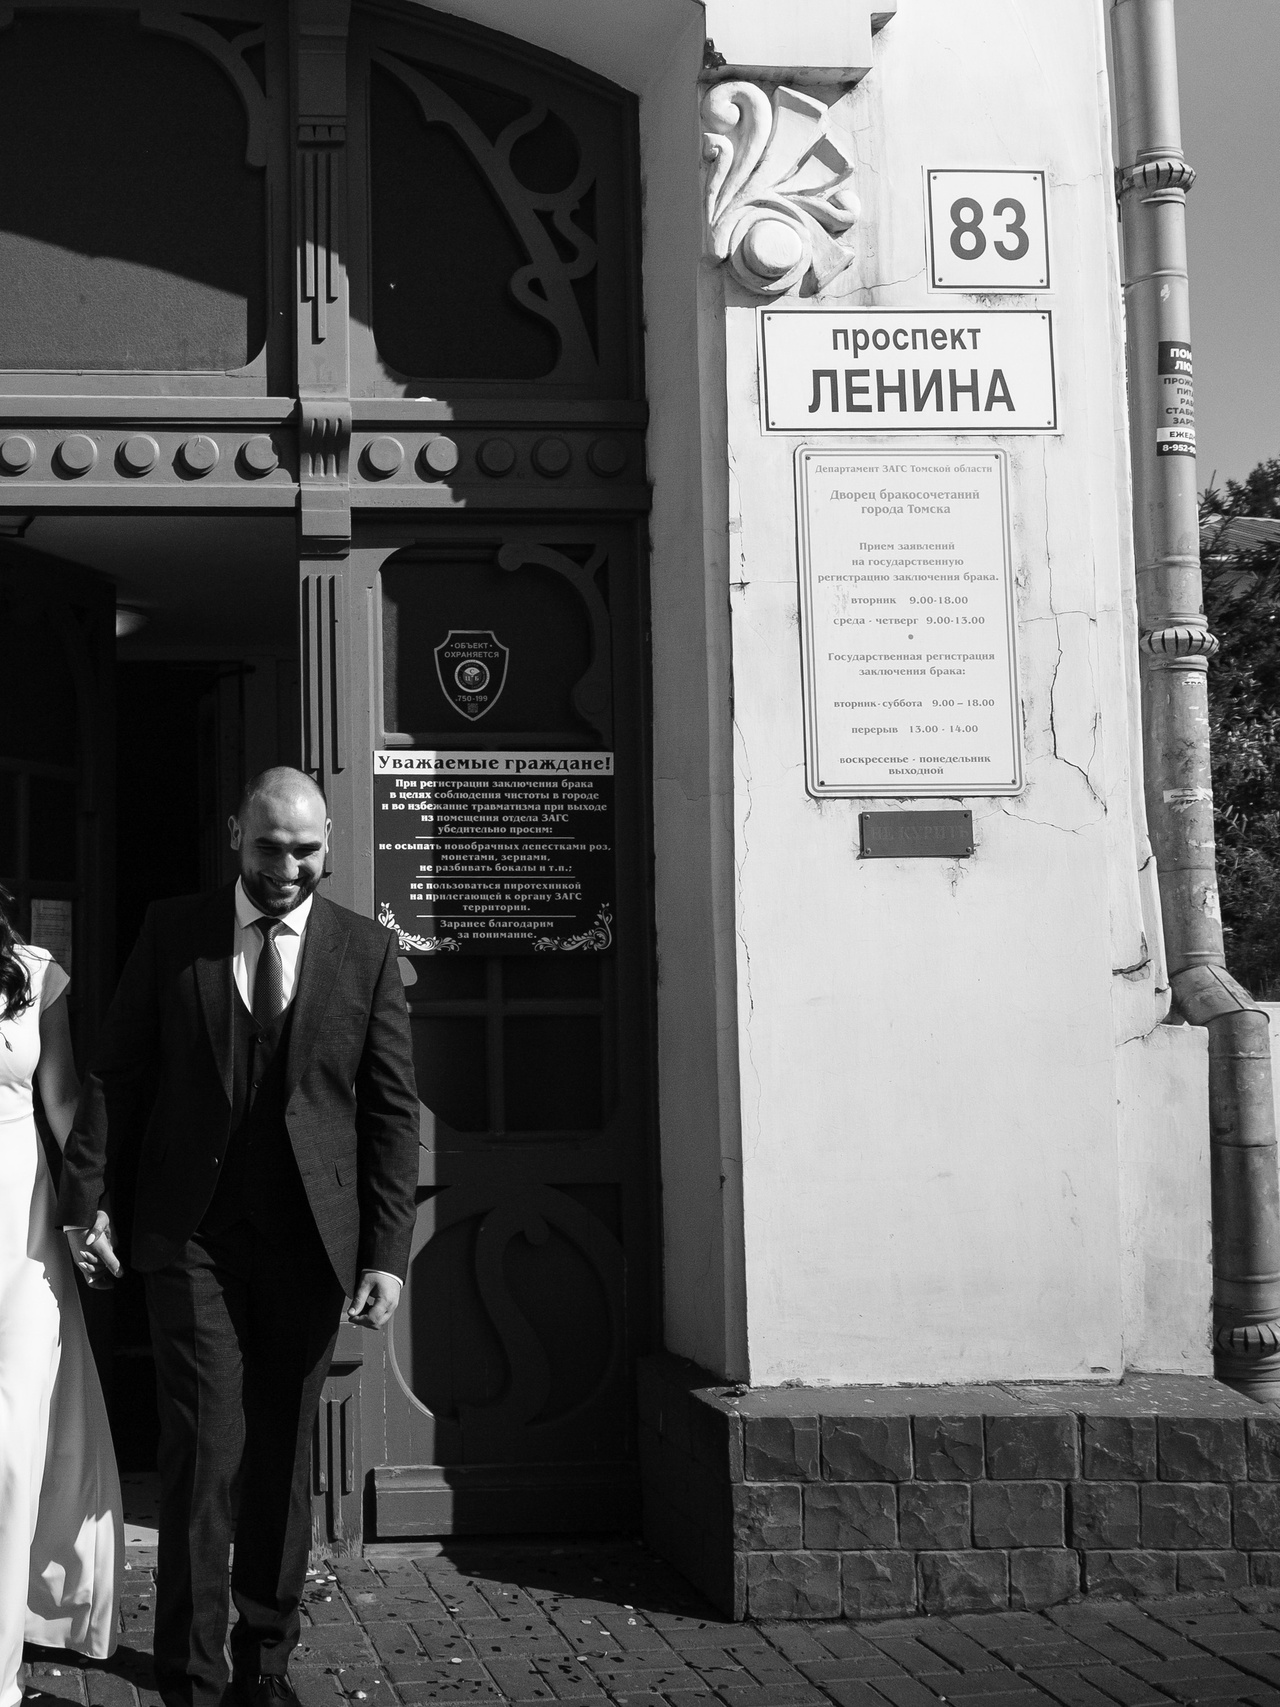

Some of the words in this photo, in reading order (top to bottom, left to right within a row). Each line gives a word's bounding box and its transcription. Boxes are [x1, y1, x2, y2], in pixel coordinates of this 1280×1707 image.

[949, 197, 1030, 261] 83
[832, 327, 981, 359] проспект
[1174, 361, 1193, 374] ЛЮ
[808, 368, 1016, 413] ЛЕНИНА
[814, 464, 880, 475] Департамент
[882, 464, 908, 473] ЗАГС
[910, 463, 951, 474] Томской
[953, 463, 993, 473] области
[830, 489, 877, 502] Дворец
[879, 488, 980, 502] бракосочетаний
[861, 504, 904, 517] города
[906, 504, 951, 515] Томска
[859, 542, 895, 552] Прием
[897, 541, 955, 551] заявлений
[851, 558, 865, 566] на
[868, 558, 964, 568] государственную
[817, 573, 890, 583] регистрацию
[892, 573, 960, 582] заключения
[963, 571, 999, 582] брака.
[850, 596, 897, 606] вторник
[909, 596, 969, 605] 9.00-18.00
[833, 617, 866, 627] среда
[875, 616, 919, 626] четверг
[926, 616, 985, 625] 9.00-13.00
[827, 652, 922, 663] Государственная
[926, 652, 995, 662] регистрация
[858, 667, 926, 676] заключения
[929, 666, 966, 677] брака:
[931, 699, 955, 708] 9.00
[966, 698, 995, 707] 18.00
[851, 726, 899, 736] перерыв
[909, 724, 939, 734] 13.00
[948, 724, 979, 733] 14.00
[377, 755, 499, 770] Уважаемые
[504, 756, 611, 773] граждане!
[839, 755, 909, 766] воскресенье
[919, 755, 992, 765] понедельник
[888, 766, 945, 776] выходной
[395, 779, 417, 789] При
[420, 779, 489, 789] регистрации
[492, 779, 559, 788] заключения
[561, 778, 594, 789] брака
[399, 791, 432, 800] целях
[434, 790, 501, 800] соблюдения
[504, 792, 550, 800] чистоты
[562, 792, 600, 801] городе
[407, 801, 469, 811] избежание
[471, 803, 541, 812] травматизма
[544, 803, 565, 812] при
[567, 803, 608, 812] выходе
[436, 815, 499, 823] помещения
[502, 815, 539, 823] отдела
[541, 813, 569, 823] ЗАГС
[437, 824, 507, 835] убедительно
[509, 825, 553, 835] просим:
[444, 841, 520, 852] новобрачных
[522, 842, 587, 851] лепестками
[588, 843, 612, 852] роз,
[419, 864, 433, 872] не
[435, 863, 493, 873] разбивать
[495, 863, 537, 872] бокалы
[539, 864, 546, 872] и
[410, 882, 424, 890] не
[426, 882, 501, 890] пользоваться
[503, 880, 581, 891] пиротехникой
[425, 892, 502, 902] прилегающей
[505, 893, 512, 901] к
[514, 893, 553, 902] органу
[554, 891, 582, 901] ЗАГС
[462, 904, 531, 913] территории.
[440, 919, 486, 929] Заранее
[488, 919, 554, 930] благодарим
[472, 932, 537, 940] понимание.
